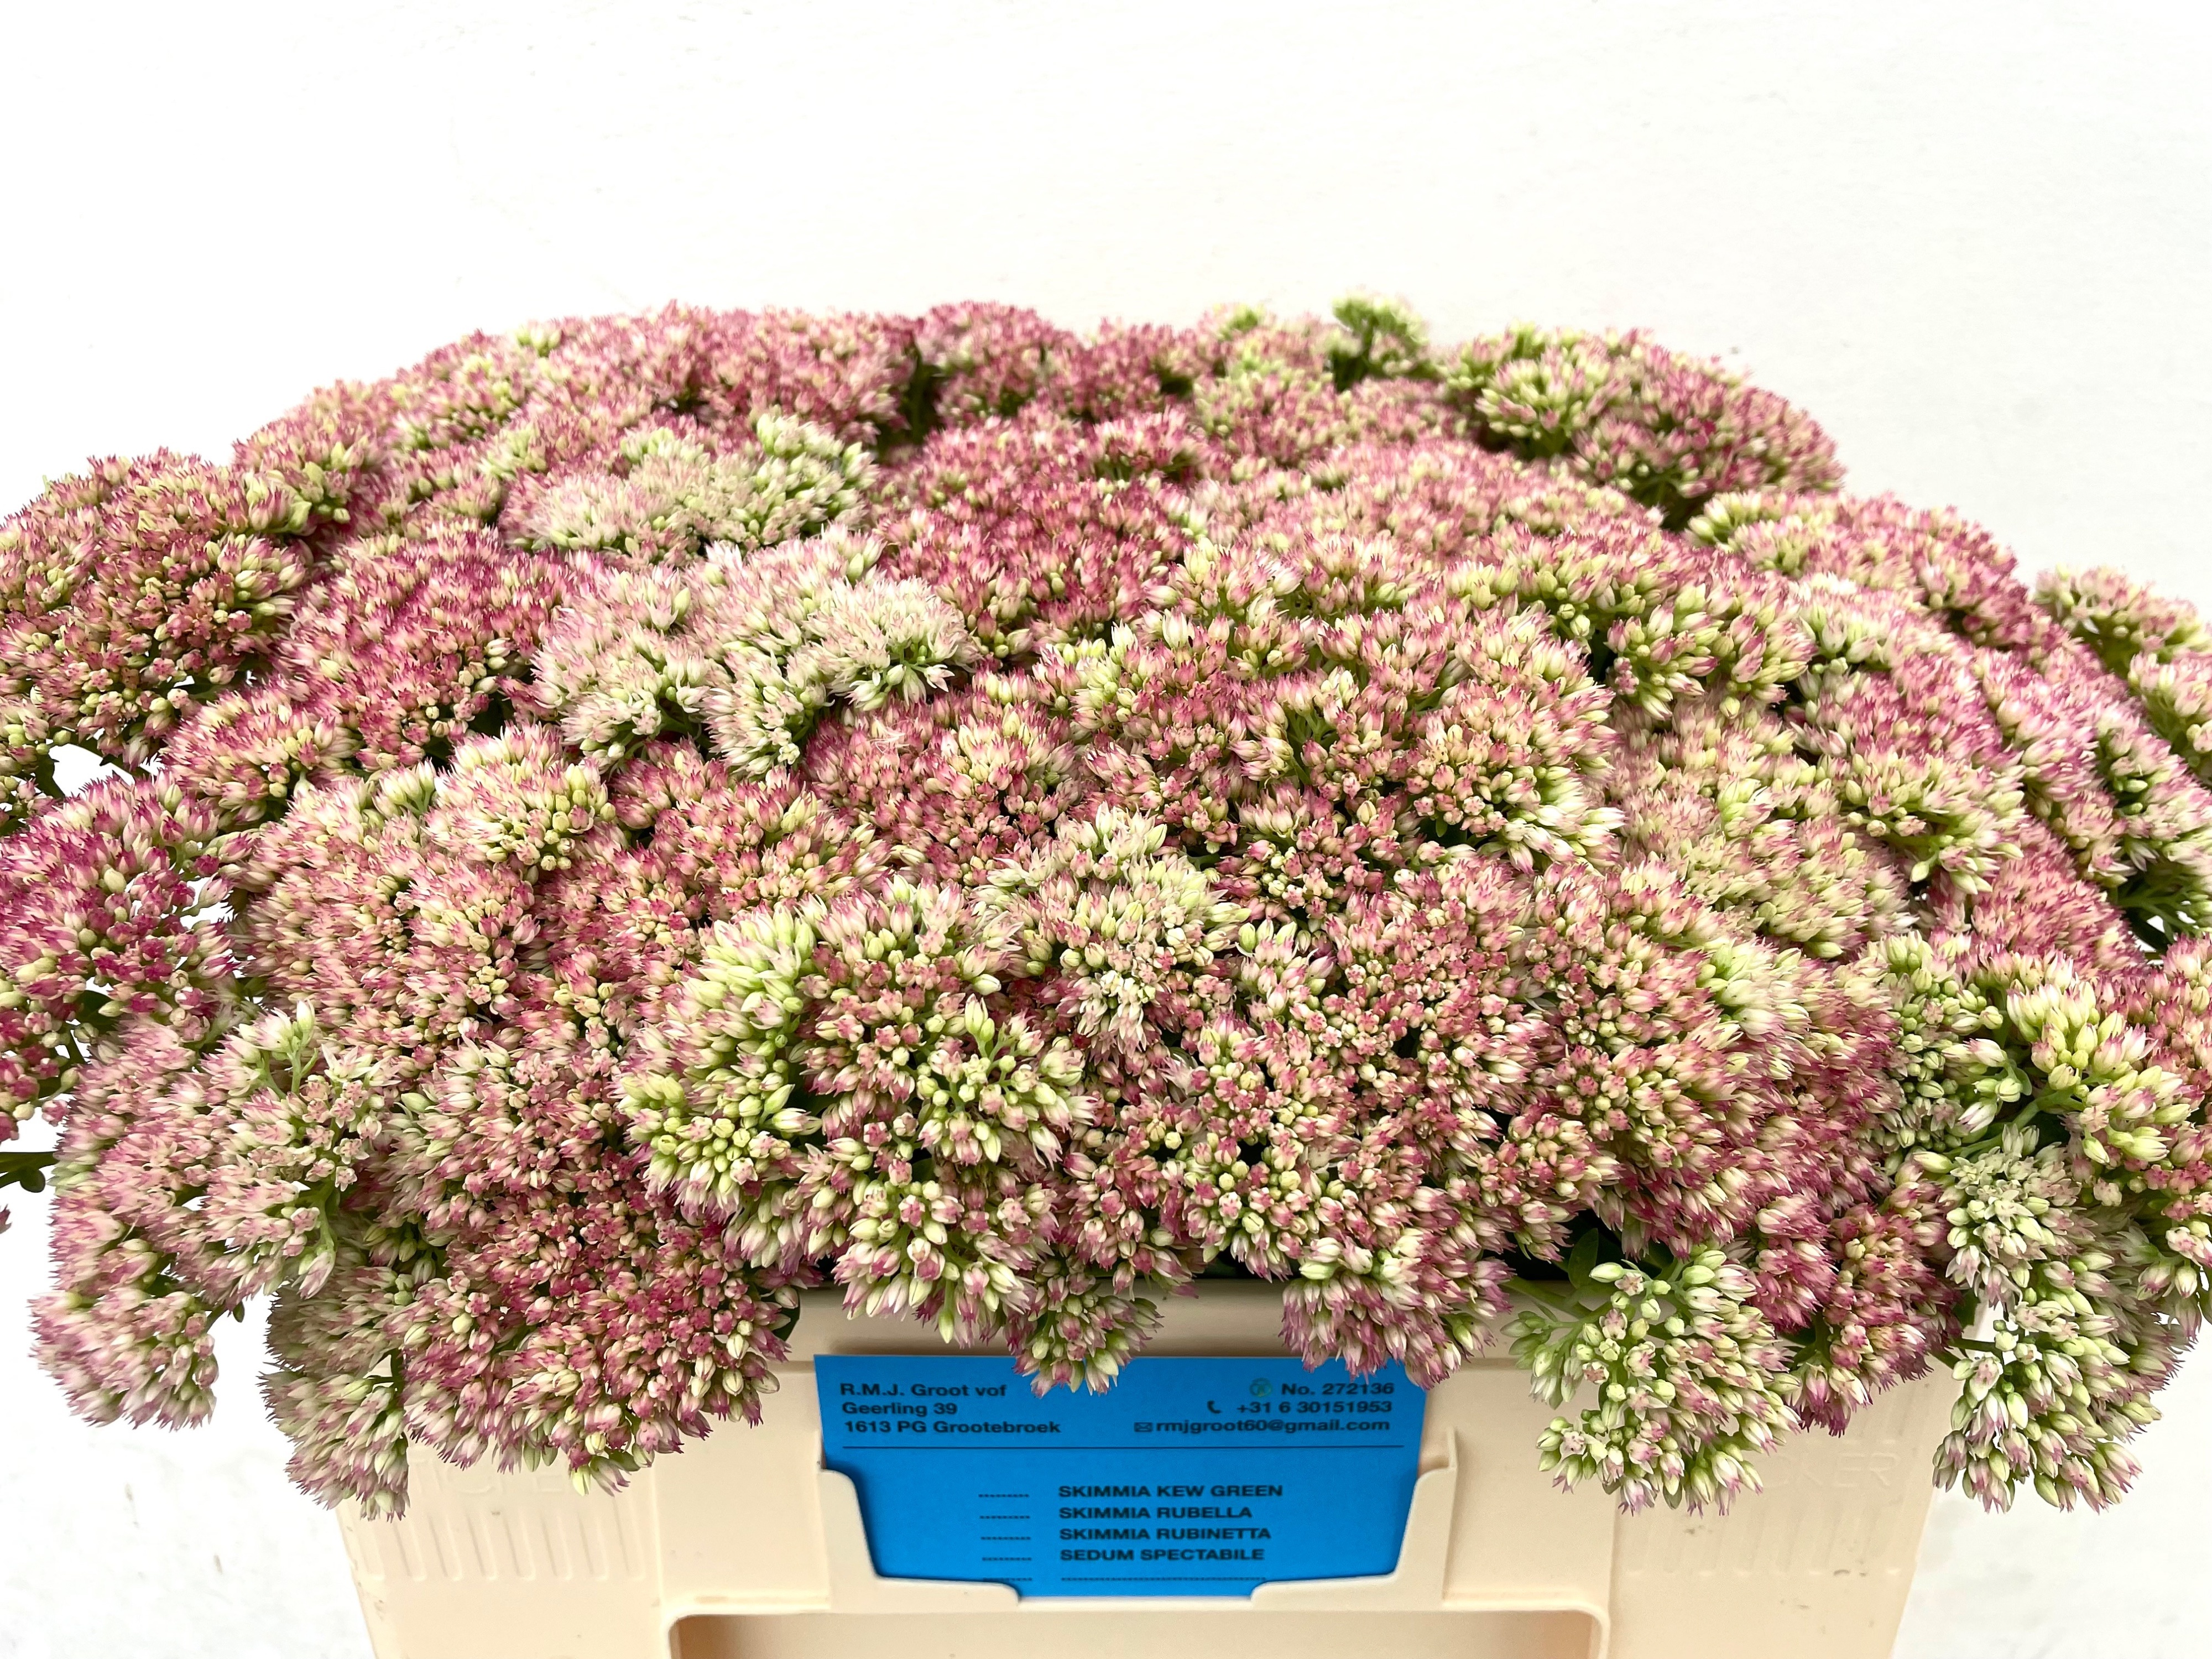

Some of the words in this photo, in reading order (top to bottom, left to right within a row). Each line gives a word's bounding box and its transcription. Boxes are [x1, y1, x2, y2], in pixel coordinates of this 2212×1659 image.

[839, 1383, 904, 1396] R.M.J.
[910, 1383, 969, 1396] Groot
[974, 1384, 1006, 1397] vof
[1281, 1383, 1315, 1395] No.
[1322, 1383, 1395, 1396] 272136
[842, 1401, 927, 1418] Geerling
[933, 1402, 958, 1415] 39
[1237, 1401, 1271, 1413] +31
[1278, 1401, 1291, 1413] 6
[1297, 1400, 1392, 1413] 30151953
[845, 1420, 891, 1433] 1613
[897, 1420, 927, 1433] PG
[933, 1421, 1061, 1433] Grootebroek
[1156, 1418, 1390, 1434] rmjgroot60@gmail.com
[1058, 1485, 1151, 1498] SKIMMIA
[1156, 1485, 1204, 1498] KEW
[1210, 1485, 1283, 1497] GREEN
[1059, 1507, 1151, 1519] SKIMMIA
[1156, 1506, 1253, 1519] RUBELLA
[1060, 1528, 1151, 1540] SKIMMIA
[1156, 1527, 1271, 1540] RUBINETTA
[1060, 1549, 1134, 1561] SEDUM
[1140, 1548, 1264, 1561] SPECTABILE
